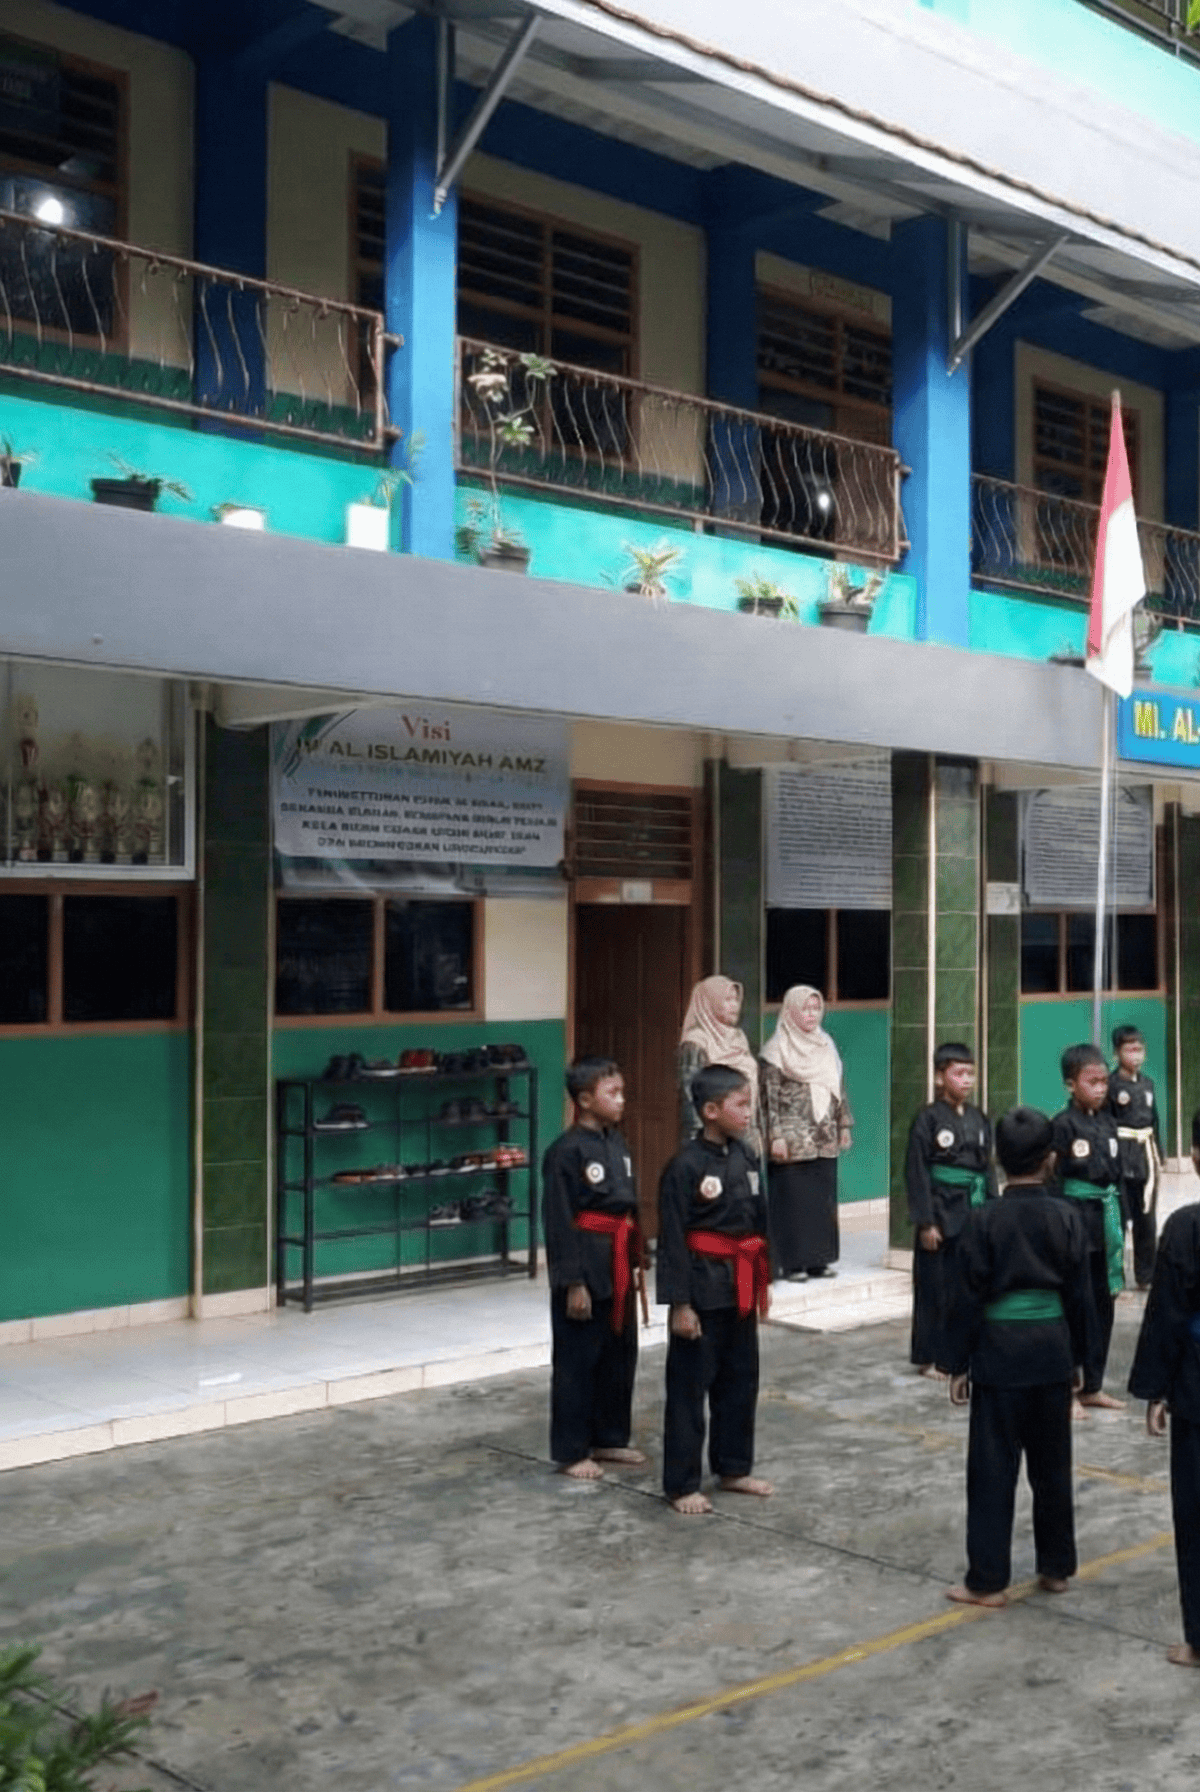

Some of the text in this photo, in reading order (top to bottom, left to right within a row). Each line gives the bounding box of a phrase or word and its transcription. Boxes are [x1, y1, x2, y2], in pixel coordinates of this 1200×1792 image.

[400, 714, 452, 741] Visi
[329, 740, 361, 758] AL
[367, 743, 493, 768] ISLAMIYAH
[498, 755, 546, 773] AMZ
